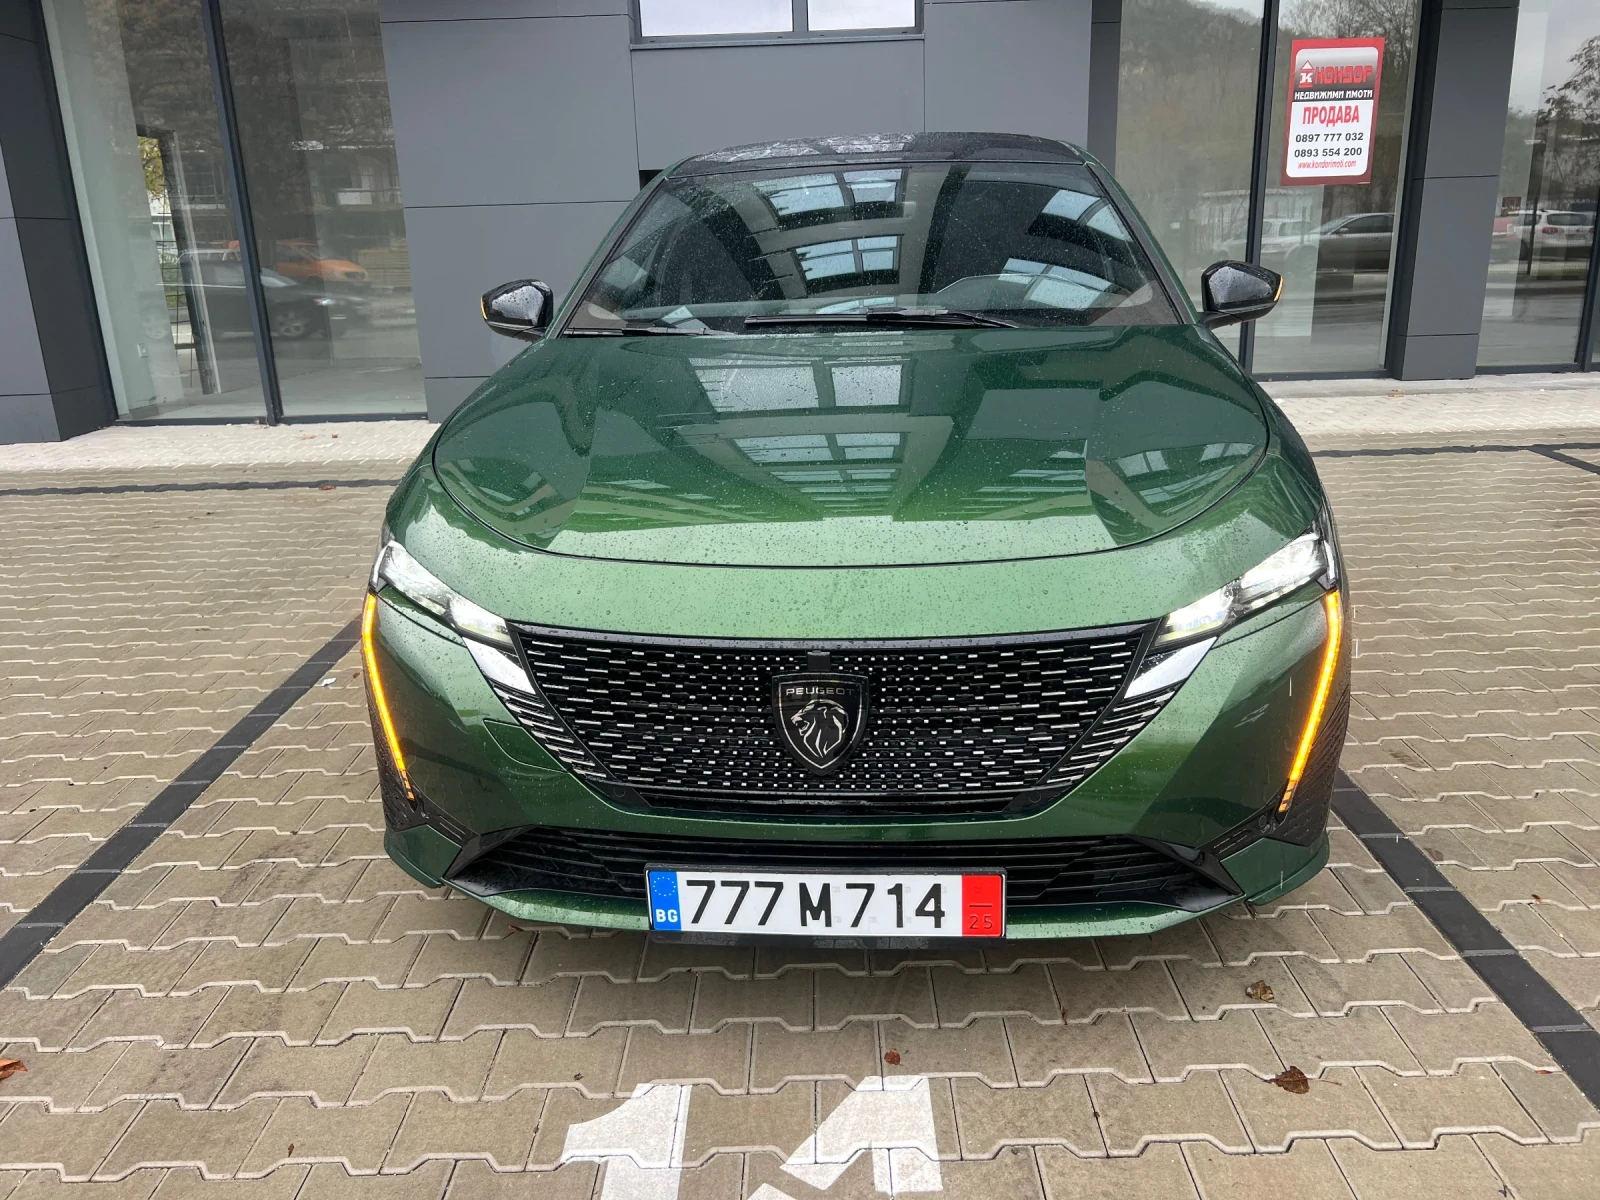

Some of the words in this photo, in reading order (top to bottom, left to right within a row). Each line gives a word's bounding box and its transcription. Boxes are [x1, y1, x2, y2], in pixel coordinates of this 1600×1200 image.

[1294, 90, 1344, 100] НЕДВИЖИМИ
[1346, 89, 1373, 98] ИМОТИ
[1302, 105, 1360, 127] ПРОДАВА
[1295, 133, 1320, 143] 0897
[1324, 133, 1342, 142] 777
[1345, 132, 1364, 141] 032
[1294, 148, 1319, 158] 0893
[1322, 148, 1340, 157] 554
[1343, 147, 1362, 156] 200
[1297, 159, 1357, 169] www.kondorimoti.com
[785, 686, 855, 696] PEUGEOT
[686, 879, 784, 926] 777
[799, 882, 832, 928] M
[845, 882, 946, 929] 714
[656, 909, 678, 923] BG
[969, 915, 993, 930] 25
